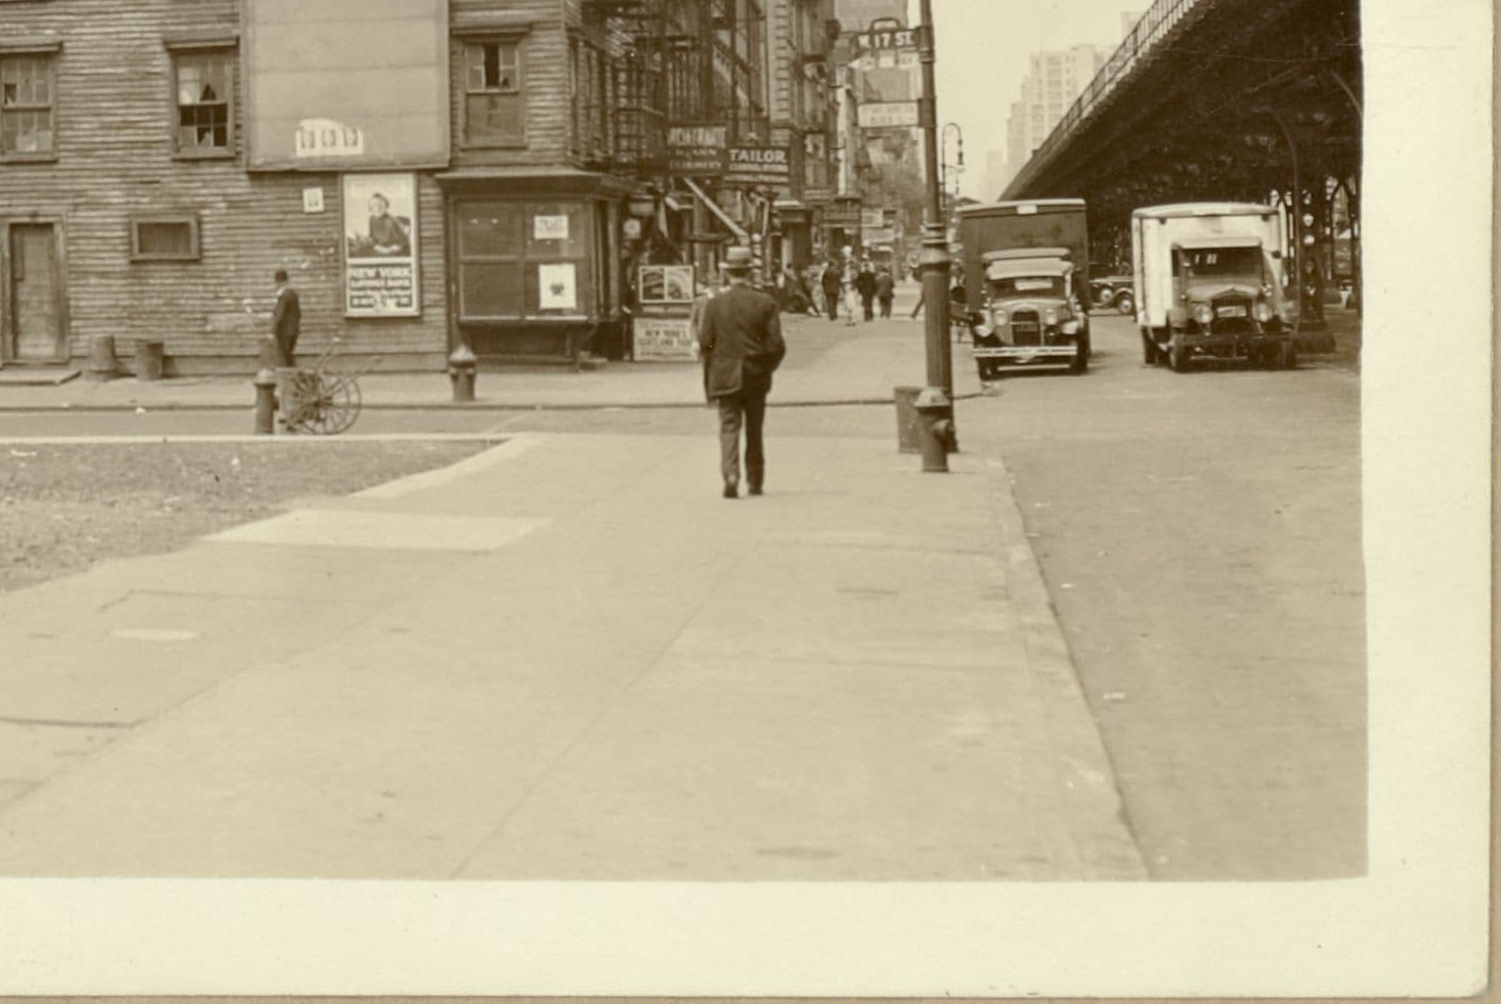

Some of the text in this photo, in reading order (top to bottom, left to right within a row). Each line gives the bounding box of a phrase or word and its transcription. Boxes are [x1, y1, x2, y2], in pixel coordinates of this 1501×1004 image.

[874, 33, 891, 49] 17
[728, 149, 787, 163] TAILOR
[378, 267, 410, 278] YORK
